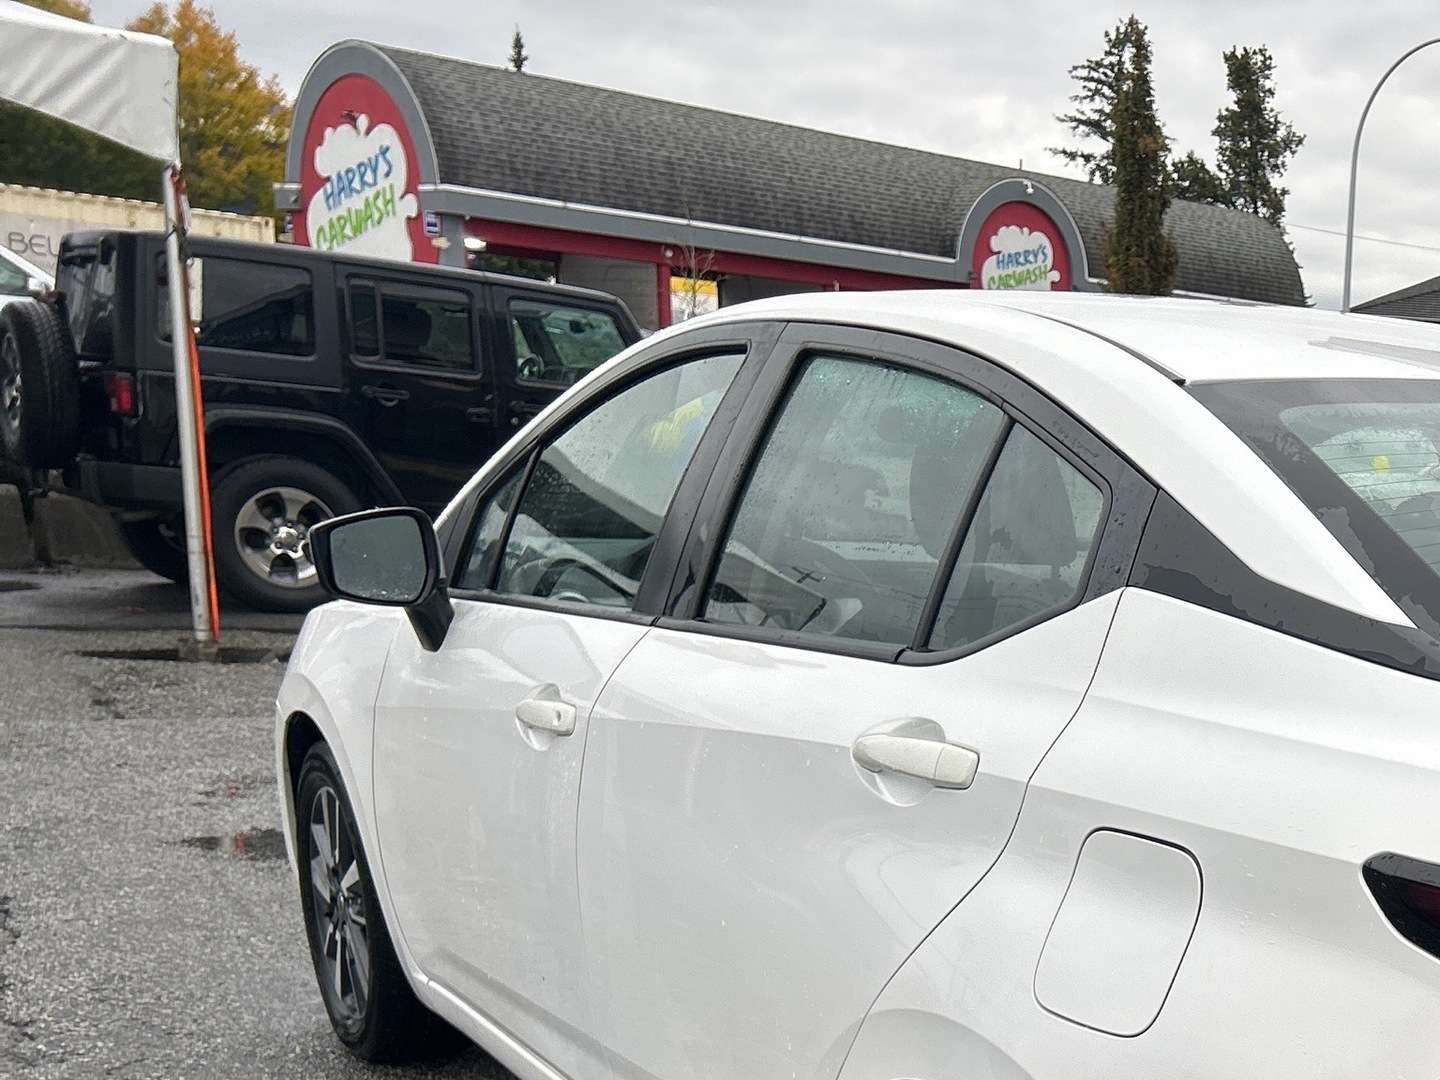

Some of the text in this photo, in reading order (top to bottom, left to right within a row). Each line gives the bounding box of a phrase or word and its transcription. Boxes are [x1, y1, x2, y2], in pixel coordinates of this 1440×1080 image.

[323, 144, 393, 212] HARRY'S
[316, 183, 396, 251] CARWASH
[987, 264, 1049, 290] CARWASH
[996, 244, 1048, 270] HARRY'S
